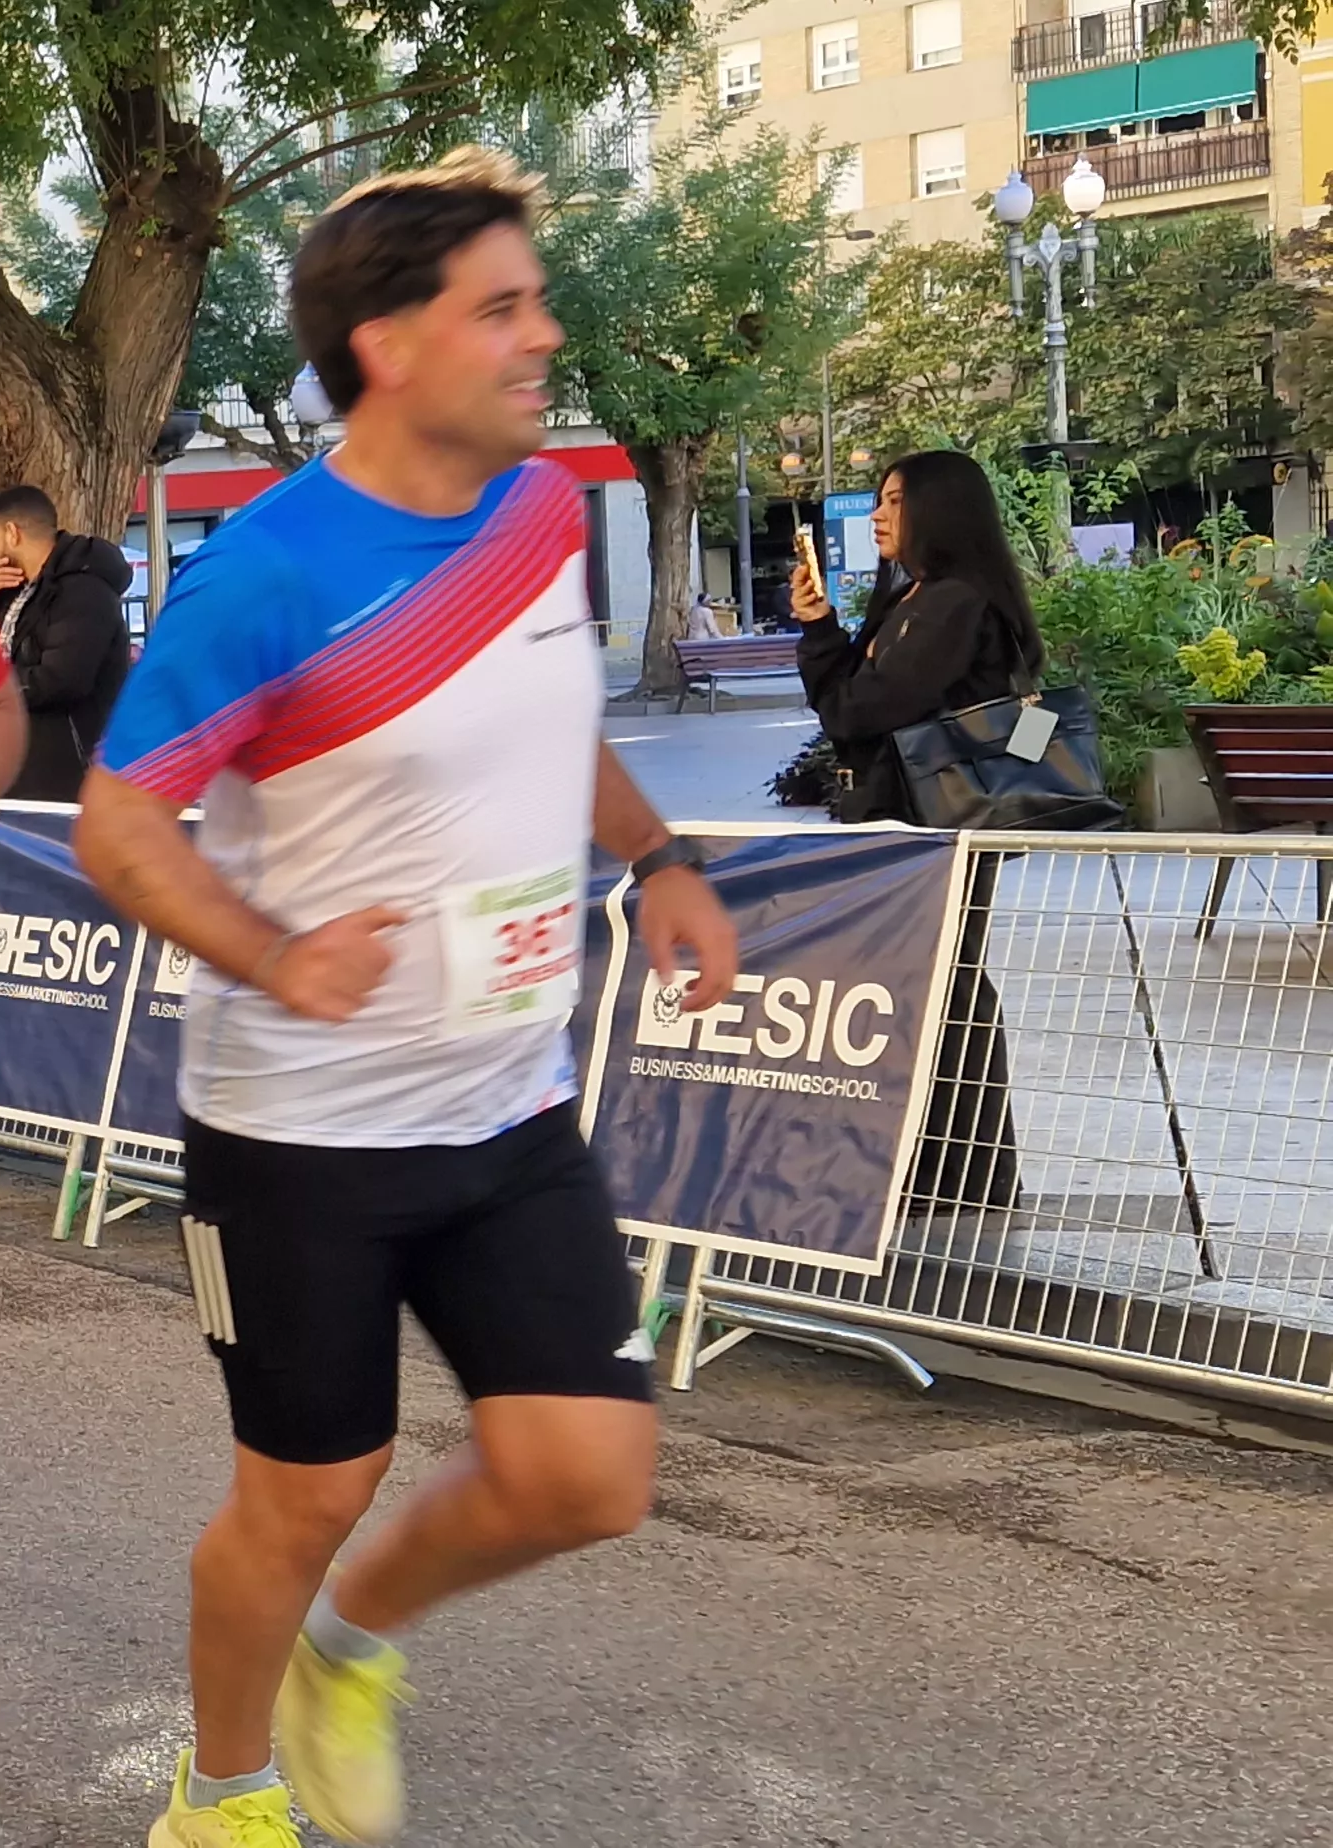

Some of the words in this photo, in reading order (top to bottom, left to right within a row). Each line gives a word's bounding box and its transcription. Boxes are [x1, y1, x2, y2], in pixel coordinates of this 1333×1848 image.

[12, 915, 121, 986] ESIC
[148, 1001, 187, 1020] BUSINE
[697, 974, 894, 1067] ESIC
[629, 1056, 882, 1101] BUSINESS&MARKETINGSCHOOL
